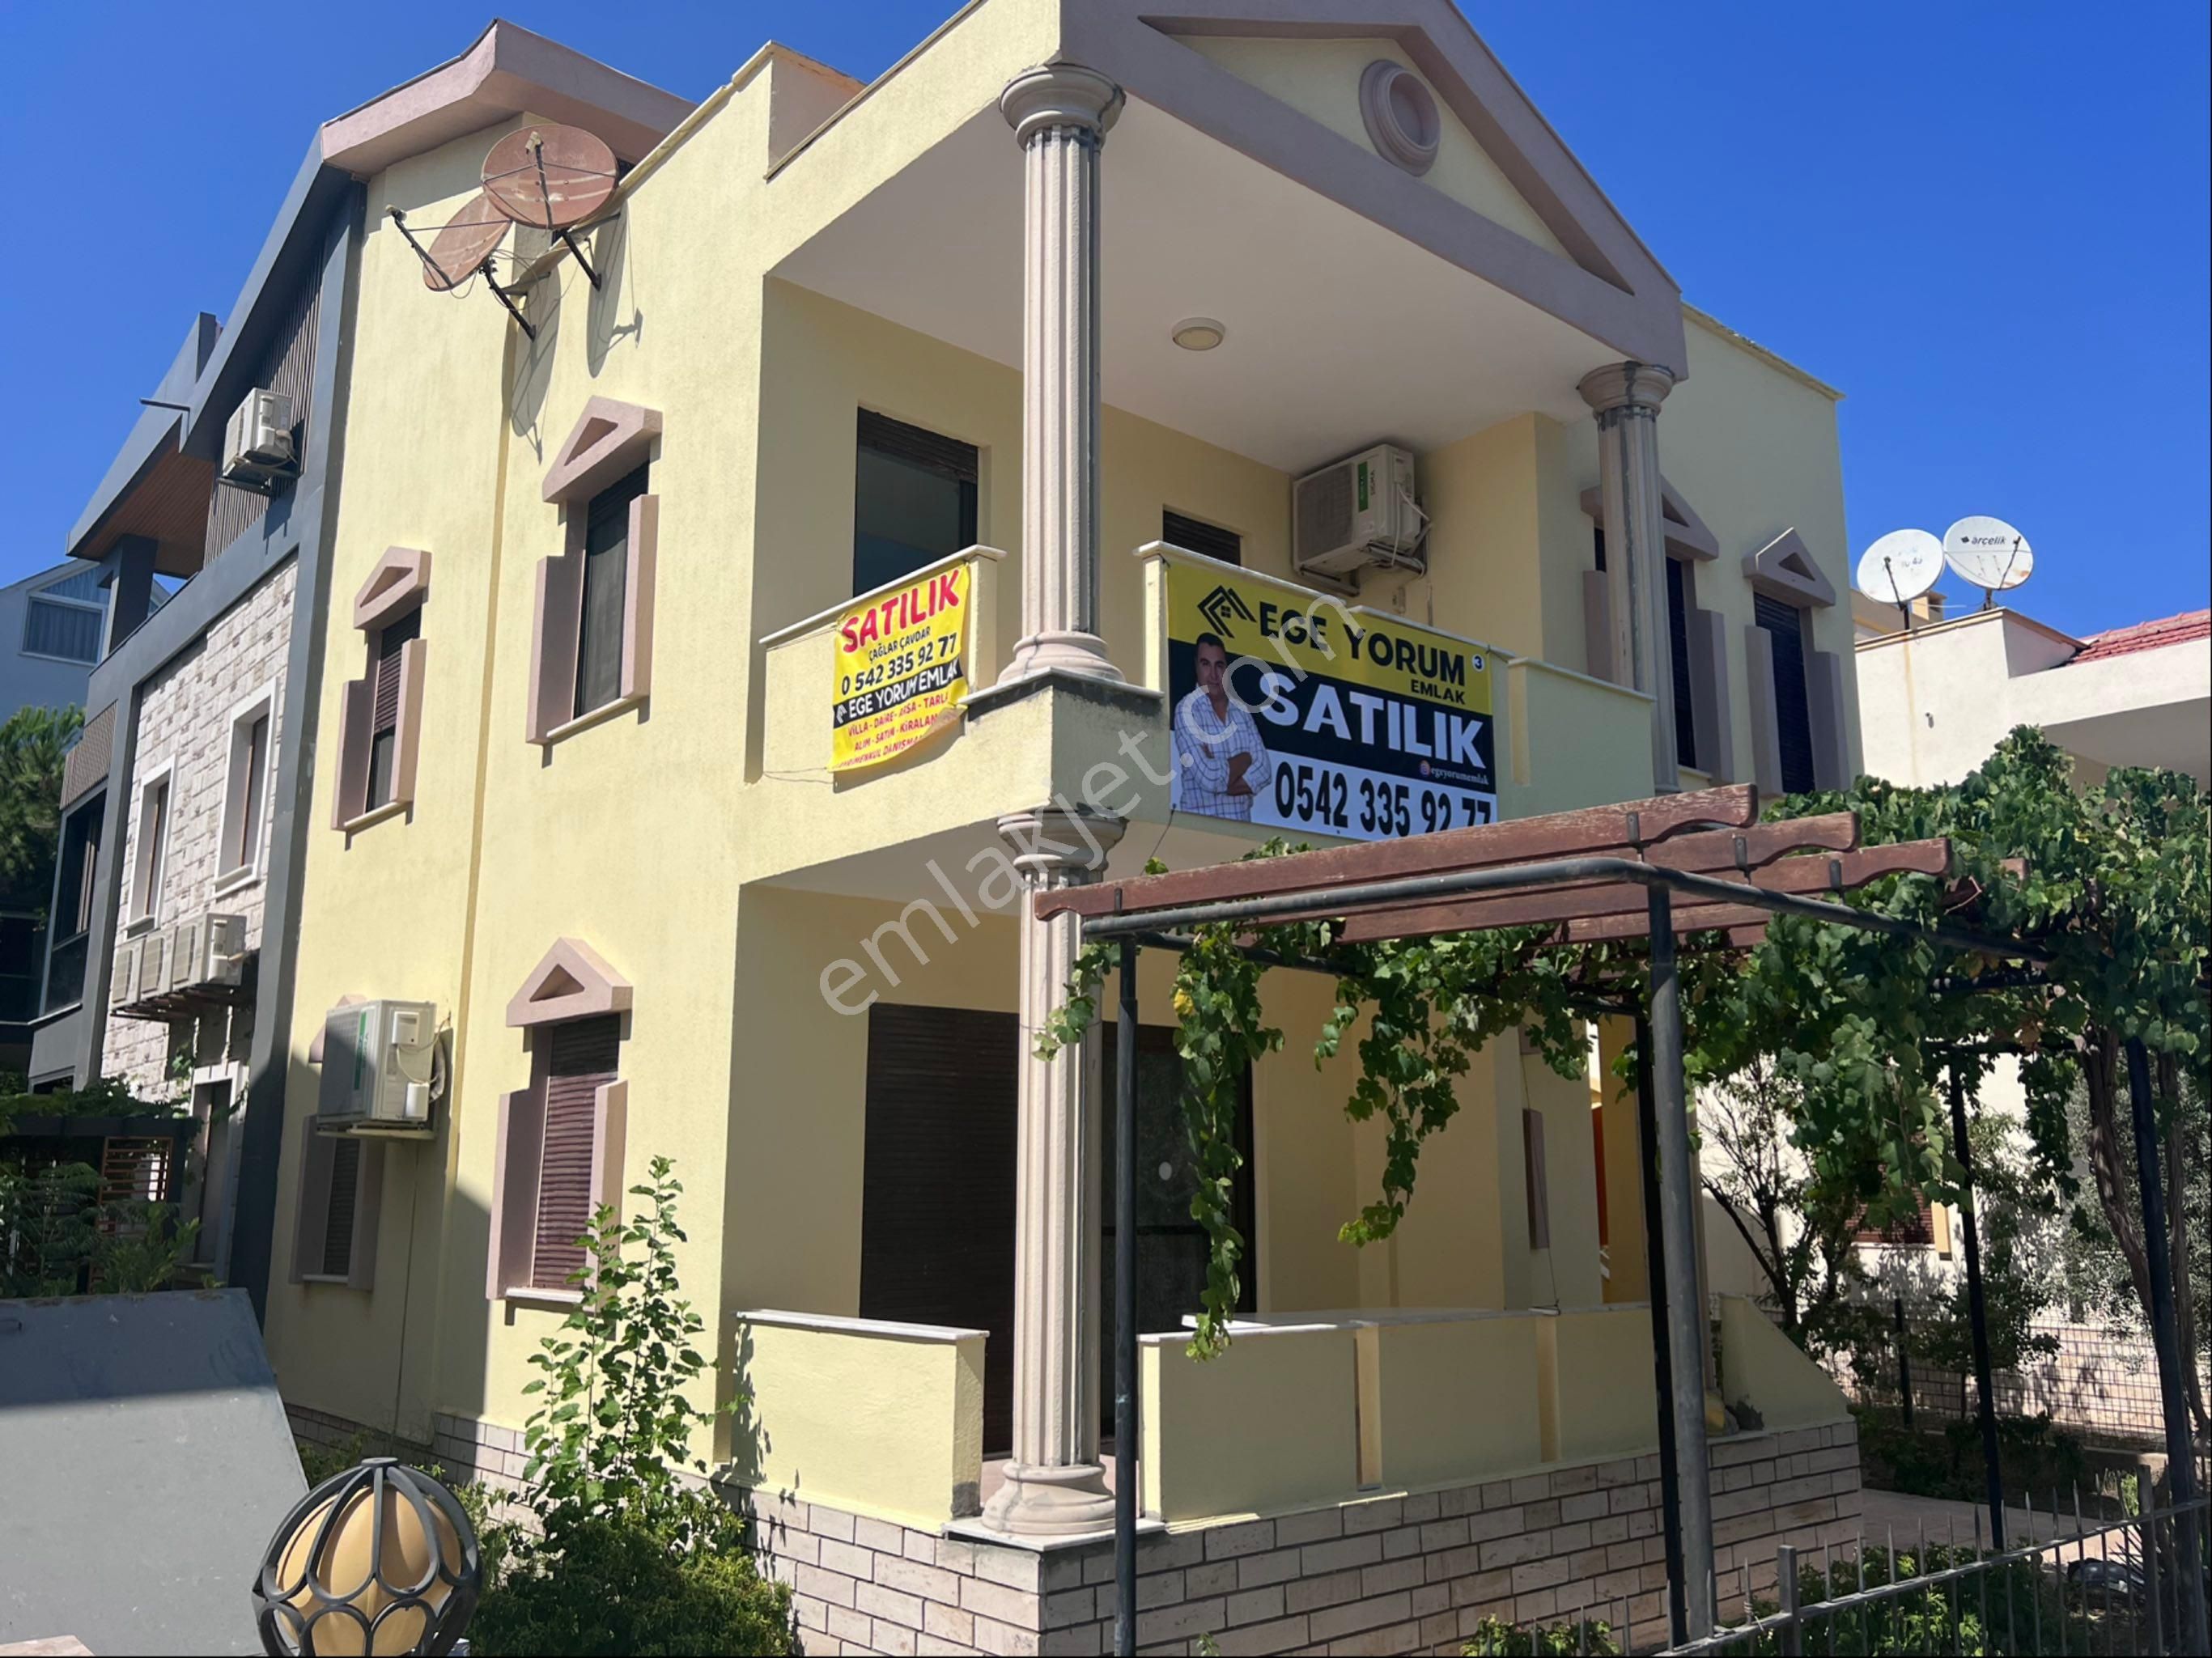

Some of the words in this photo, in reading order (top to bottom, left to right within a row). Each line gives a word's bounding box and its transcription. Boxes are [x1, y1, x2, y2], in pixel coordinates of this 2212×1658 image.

[843, 569, 960, 653] SATILIK
[868, 640, 898, 663] ÇAĞLAR
[899, 625, 931, 650] ÇAVDAR
[1259, 602, 1328, 651] EGE
[1343, 624, 1465, 686] YORUM
[842, 676, 851, 696] 0
[855, 664, 884, 692] 542
[887, 651, 914, 679] 335
[918, 642, 933, 667] 92
[938, 632, 957, 657] 77
[849, 694, 874, 719] EGE
[876, 675, 917, 709] YORUM
[919, 656, 958, 692] EMLAK
[1410, 678, 1466, 705] EMLAK
[1259, 672, 1486, 769] SATILIK
[1275, 761, 1348, 829] 0542
[1360, 777, 1411, 837] 335
[1421, 790, 1452, 833] 92
[1461, 796, 1491, 827] 77
